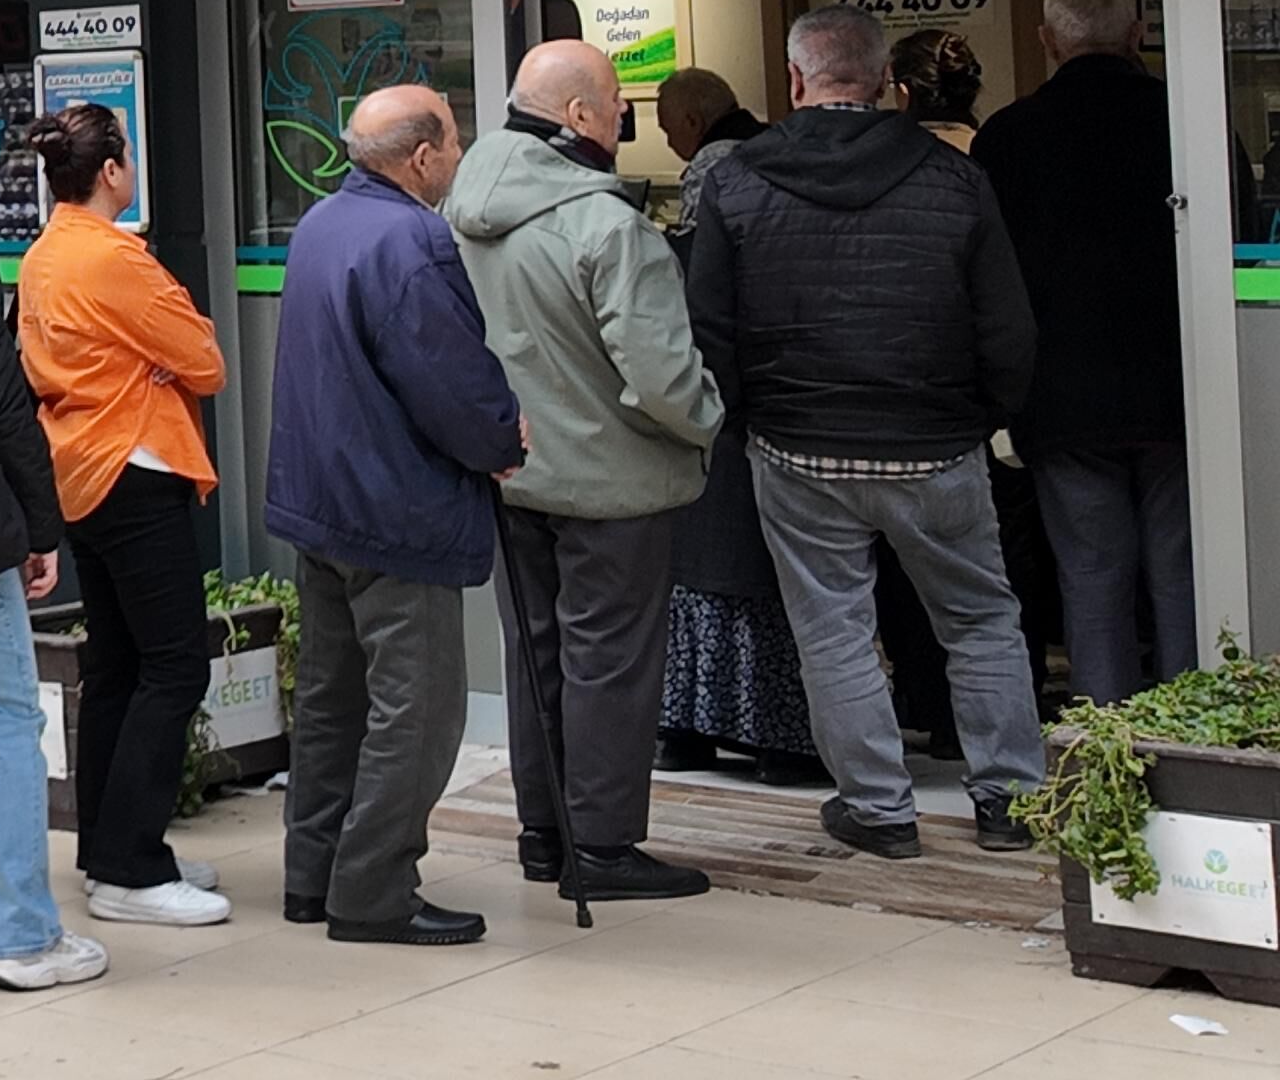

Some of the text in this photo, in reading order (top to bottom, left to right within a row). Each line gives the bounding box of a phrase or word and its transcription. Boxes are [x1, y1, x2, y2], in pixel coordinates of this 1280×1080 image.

[596, 6, 650, 25] Doğadan
[44, 16, 136, 37] 444 40 09
[606, 27, 642, 42] Gelen
[208, 675, 272, 710] KEGEET
